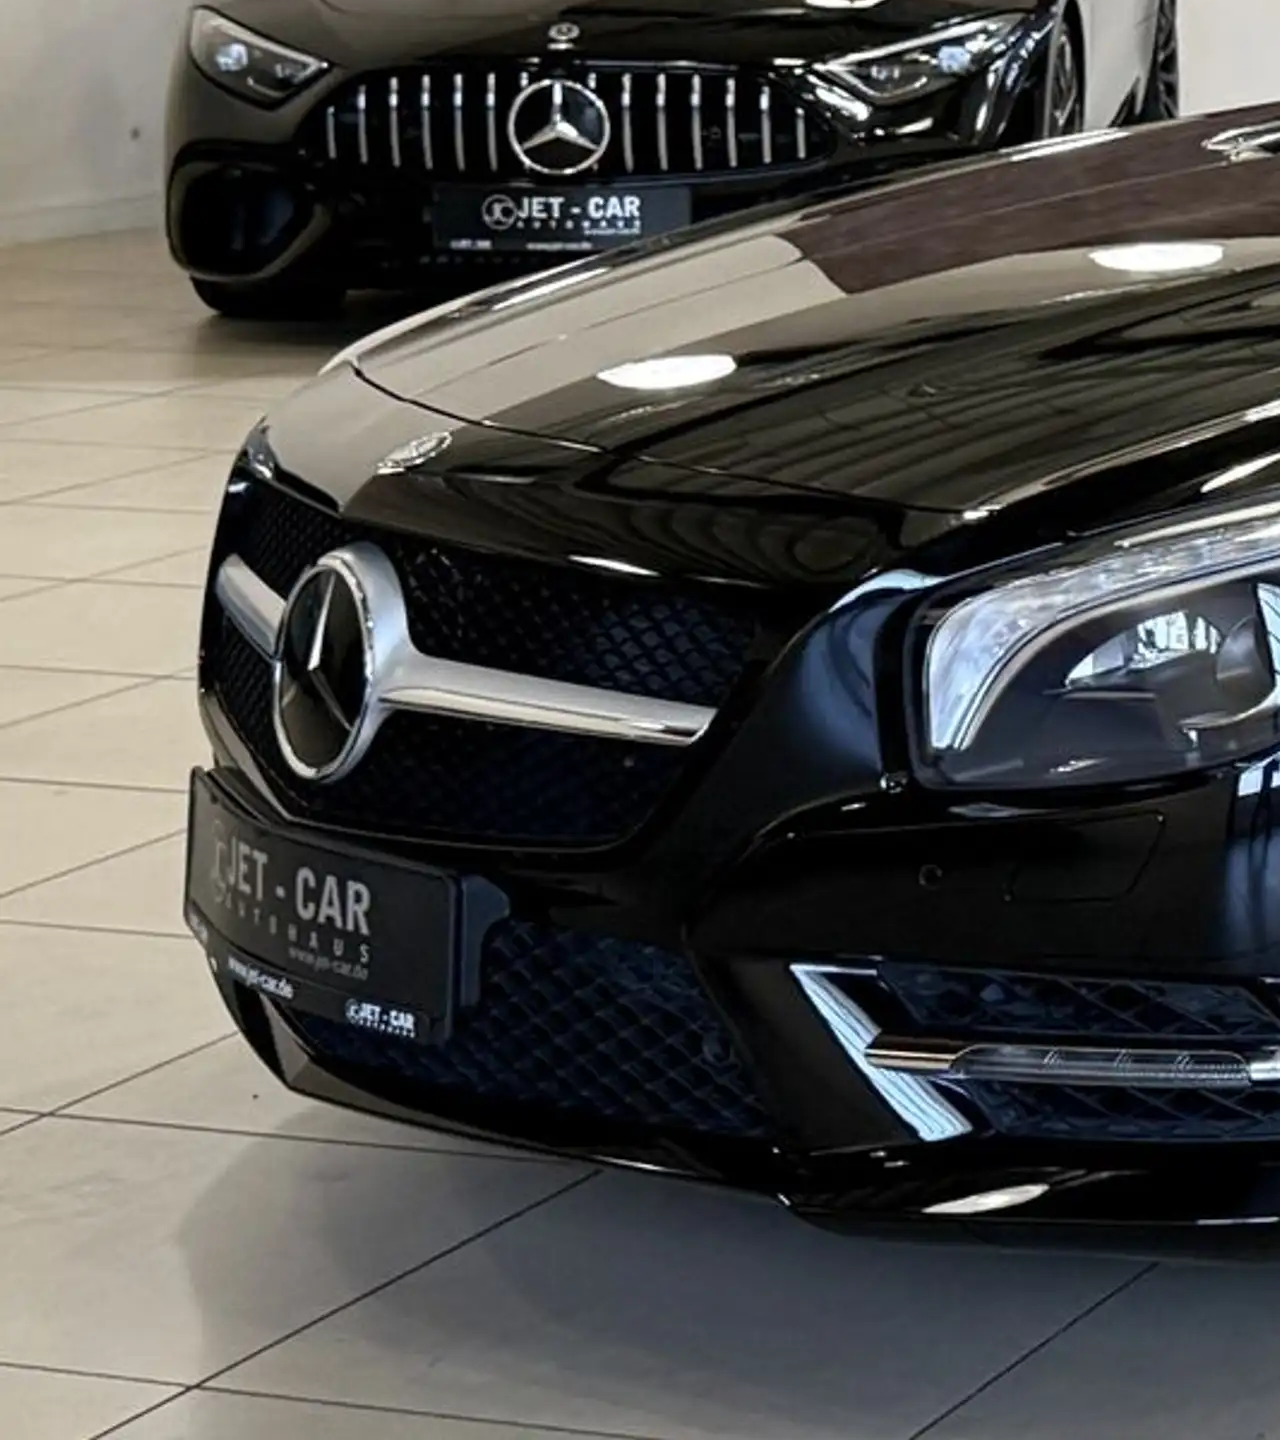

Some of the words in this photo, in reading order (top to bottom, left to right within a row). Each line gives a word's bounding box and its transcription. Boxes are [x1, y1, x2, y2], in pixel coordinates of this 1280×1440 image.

[517, 197, 565, 219] JET
[588, 195, 641, 219] CAR
[228, 836, 268, 901] JET
[295, 866, 371, 937] CAR
